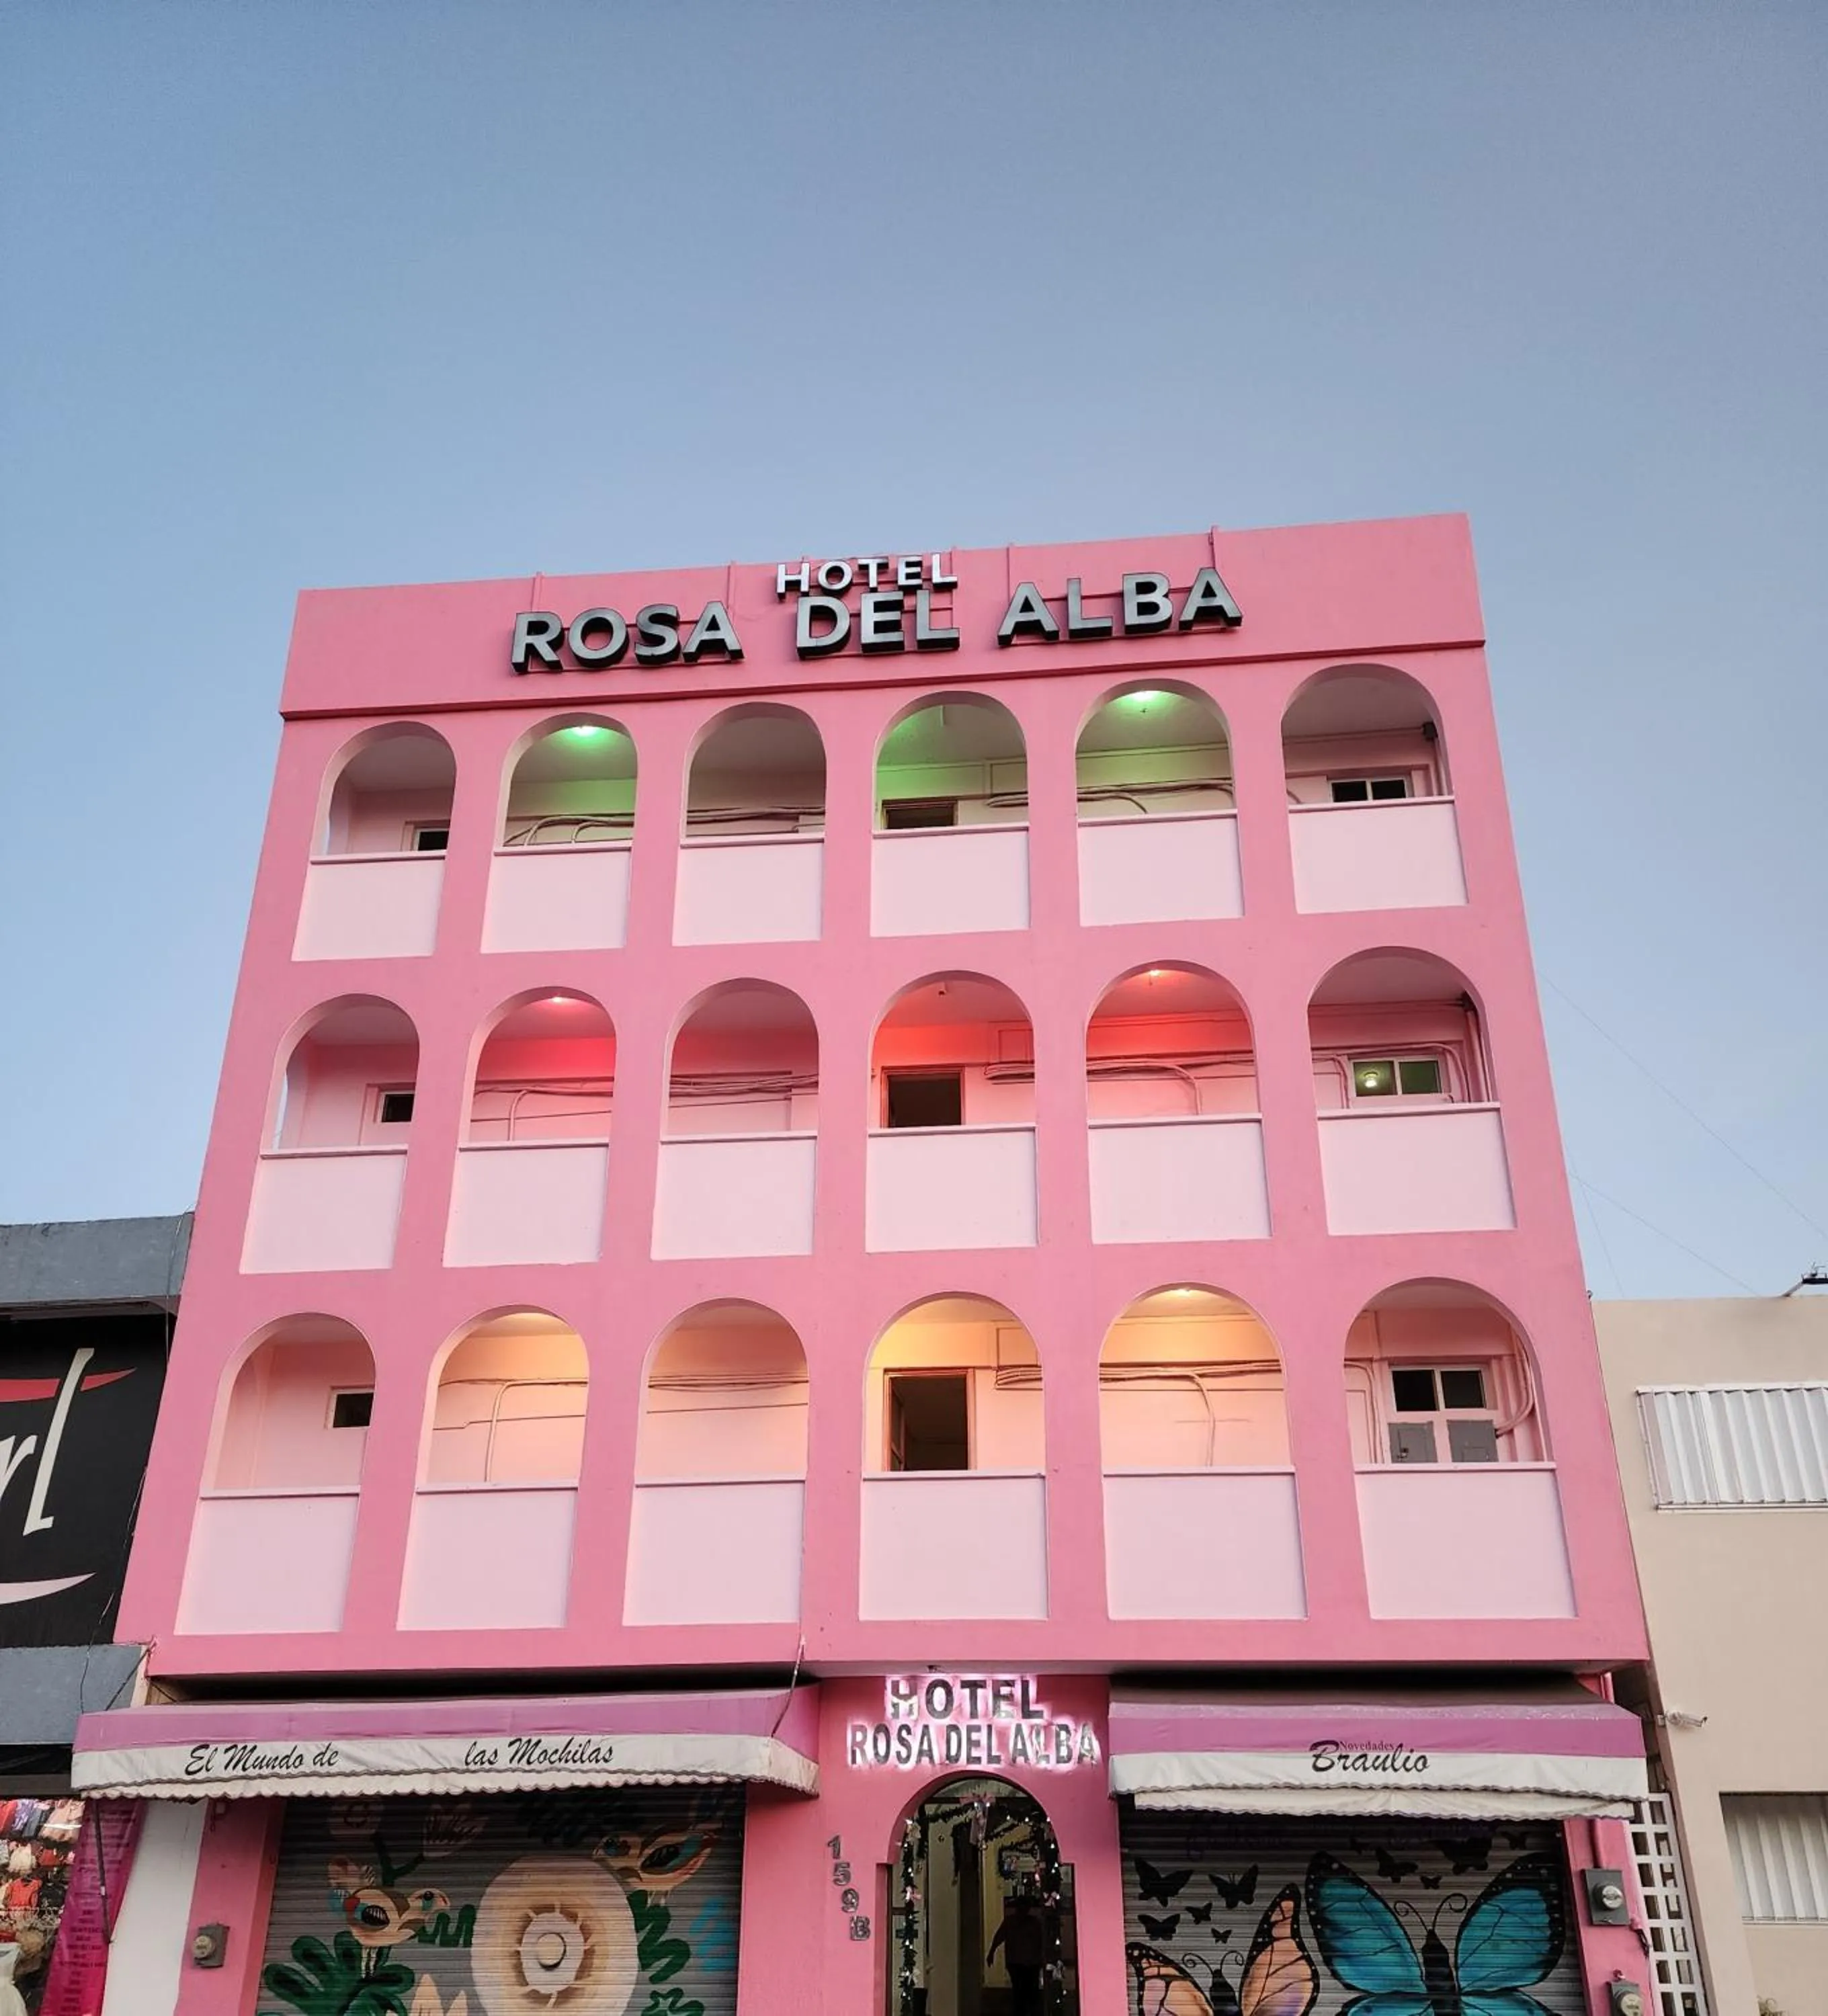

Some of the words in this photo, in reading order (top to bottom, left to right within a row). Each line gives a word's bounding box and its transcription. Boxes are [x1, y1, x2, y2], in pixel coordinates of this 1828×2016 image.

[776, 552, 958, 601] HOTEL
[511, 600, 744, 675] ROSA
[796, 589, 960, 661] DEL
[997, 566, 1243, 648] ALBA
[890, 1678, 1044, 1720] HOTEL
[184, 1744, 218, 1775] El
[222, 1744, 304, 1772] Mundo
[313, 1742, 339, 1767] de
[464, 1740, 498, 1766] las
[508, 1736, 614, 1765] Mochilas
[850, 1723, 936, 1765] ROSA
[945, 1723, 1002, 1765] DEL
[1011, 1722, 1098, 1765] ALBA
[1309, 1740, 1429, 1773] Braulio
[1339, 1740, 1395, 1751] Novedades
